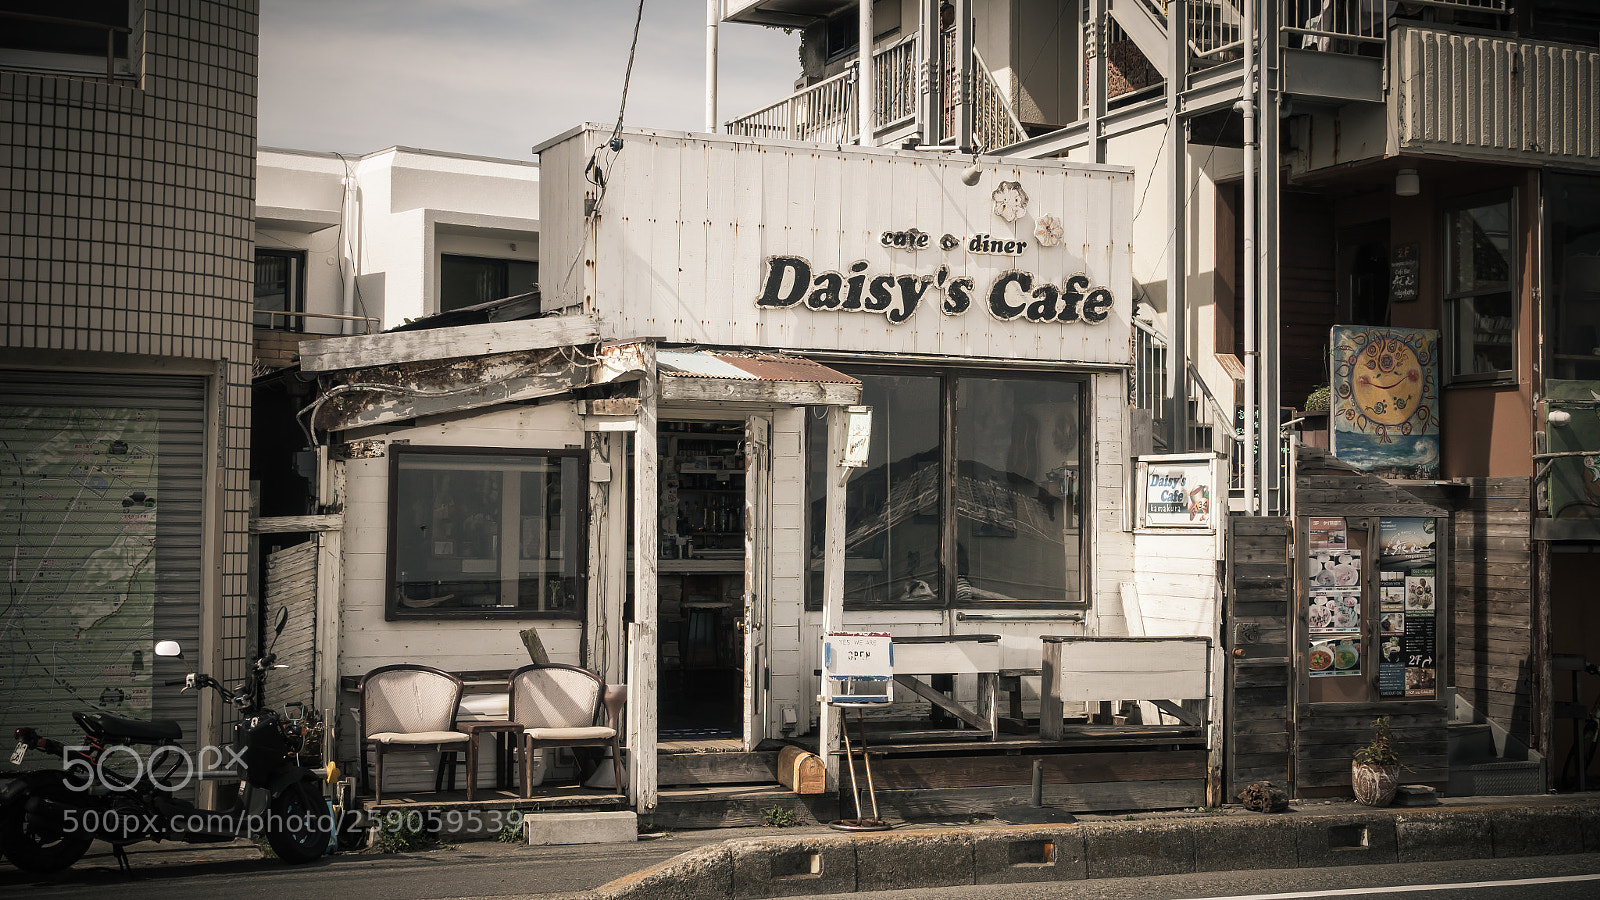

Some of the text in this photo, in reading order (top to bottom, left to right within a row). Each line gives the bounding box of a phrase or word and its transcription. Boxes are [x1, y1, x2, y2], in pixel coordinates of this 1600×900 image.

[969, 234, 1027, 254] diner
[756, 255, 1114, 323] Daisy's Cafe
[1150, 474, 1186, 489] Daisy's
[1161, 490, 1184, 502] Cafe
[848, 651, 871, 660] OPEN
[1408, 654, 1423, 666] 2F
